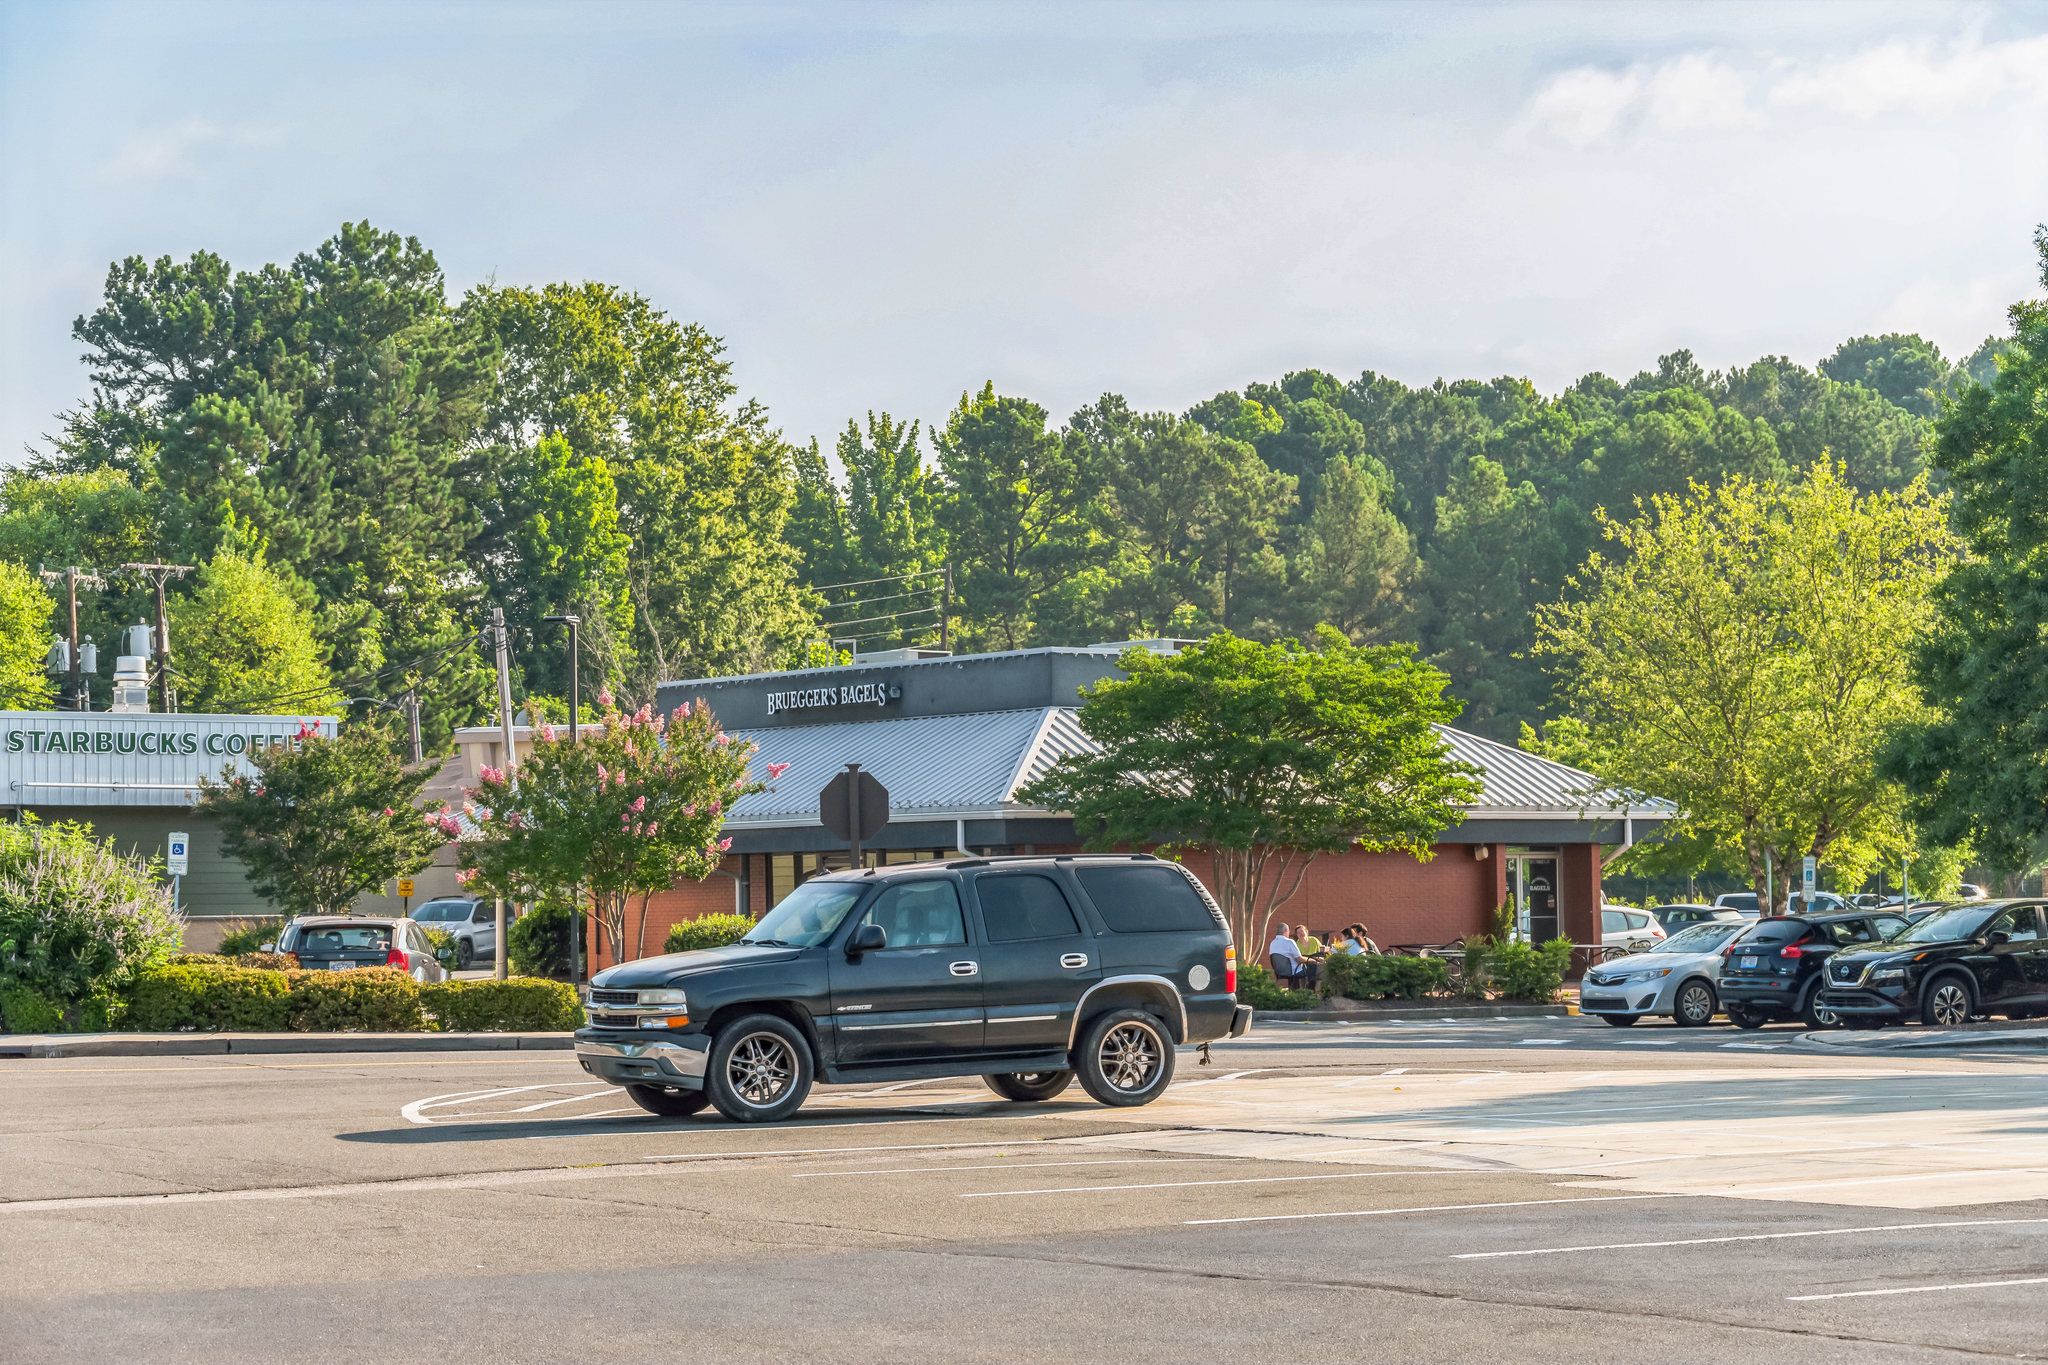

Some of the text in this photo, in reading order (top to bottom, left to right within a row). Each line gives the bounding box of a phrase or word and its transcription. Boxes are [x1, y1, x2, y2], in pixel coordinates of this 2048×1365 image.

[767, 683, 886, 715] BRUEGGER'S BAGELS
[7, 729, 198, 755] STARBUCKS
